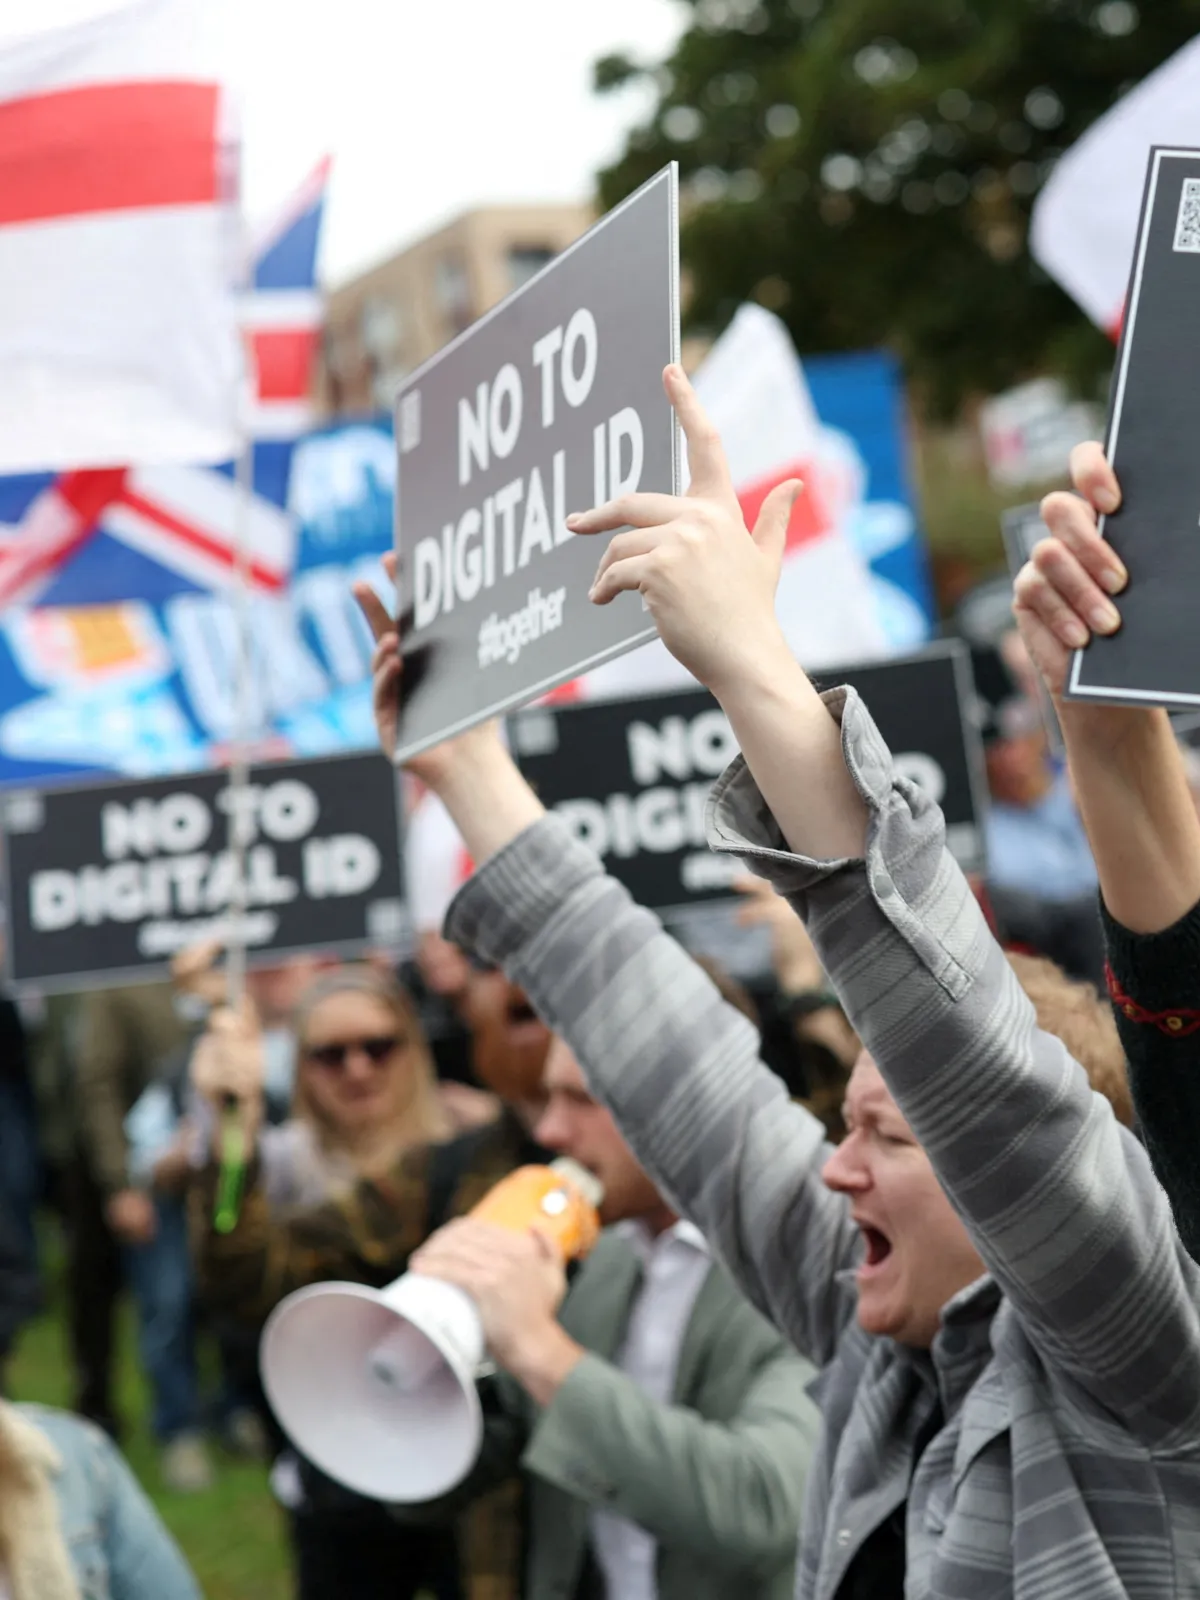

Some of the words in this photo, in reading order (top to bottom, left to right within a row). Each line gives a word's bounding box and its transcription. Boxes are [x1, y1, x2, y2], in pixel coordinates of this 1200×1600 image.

[458, 363, 523, 486] NO
[533, 307, 598, 428] TO
[414, 449, 576, 631] DIGITAL
[593, 406, 645, 508] ID
[477, 586, 567, 669] #together
[628, 709, 742, 786] NO
[102, 792, 212, 861] NO
[216, 778, 320, 842] TO
[30, 844, 299, 932] DIGITAL
[303, 832, 381, 898] ID
